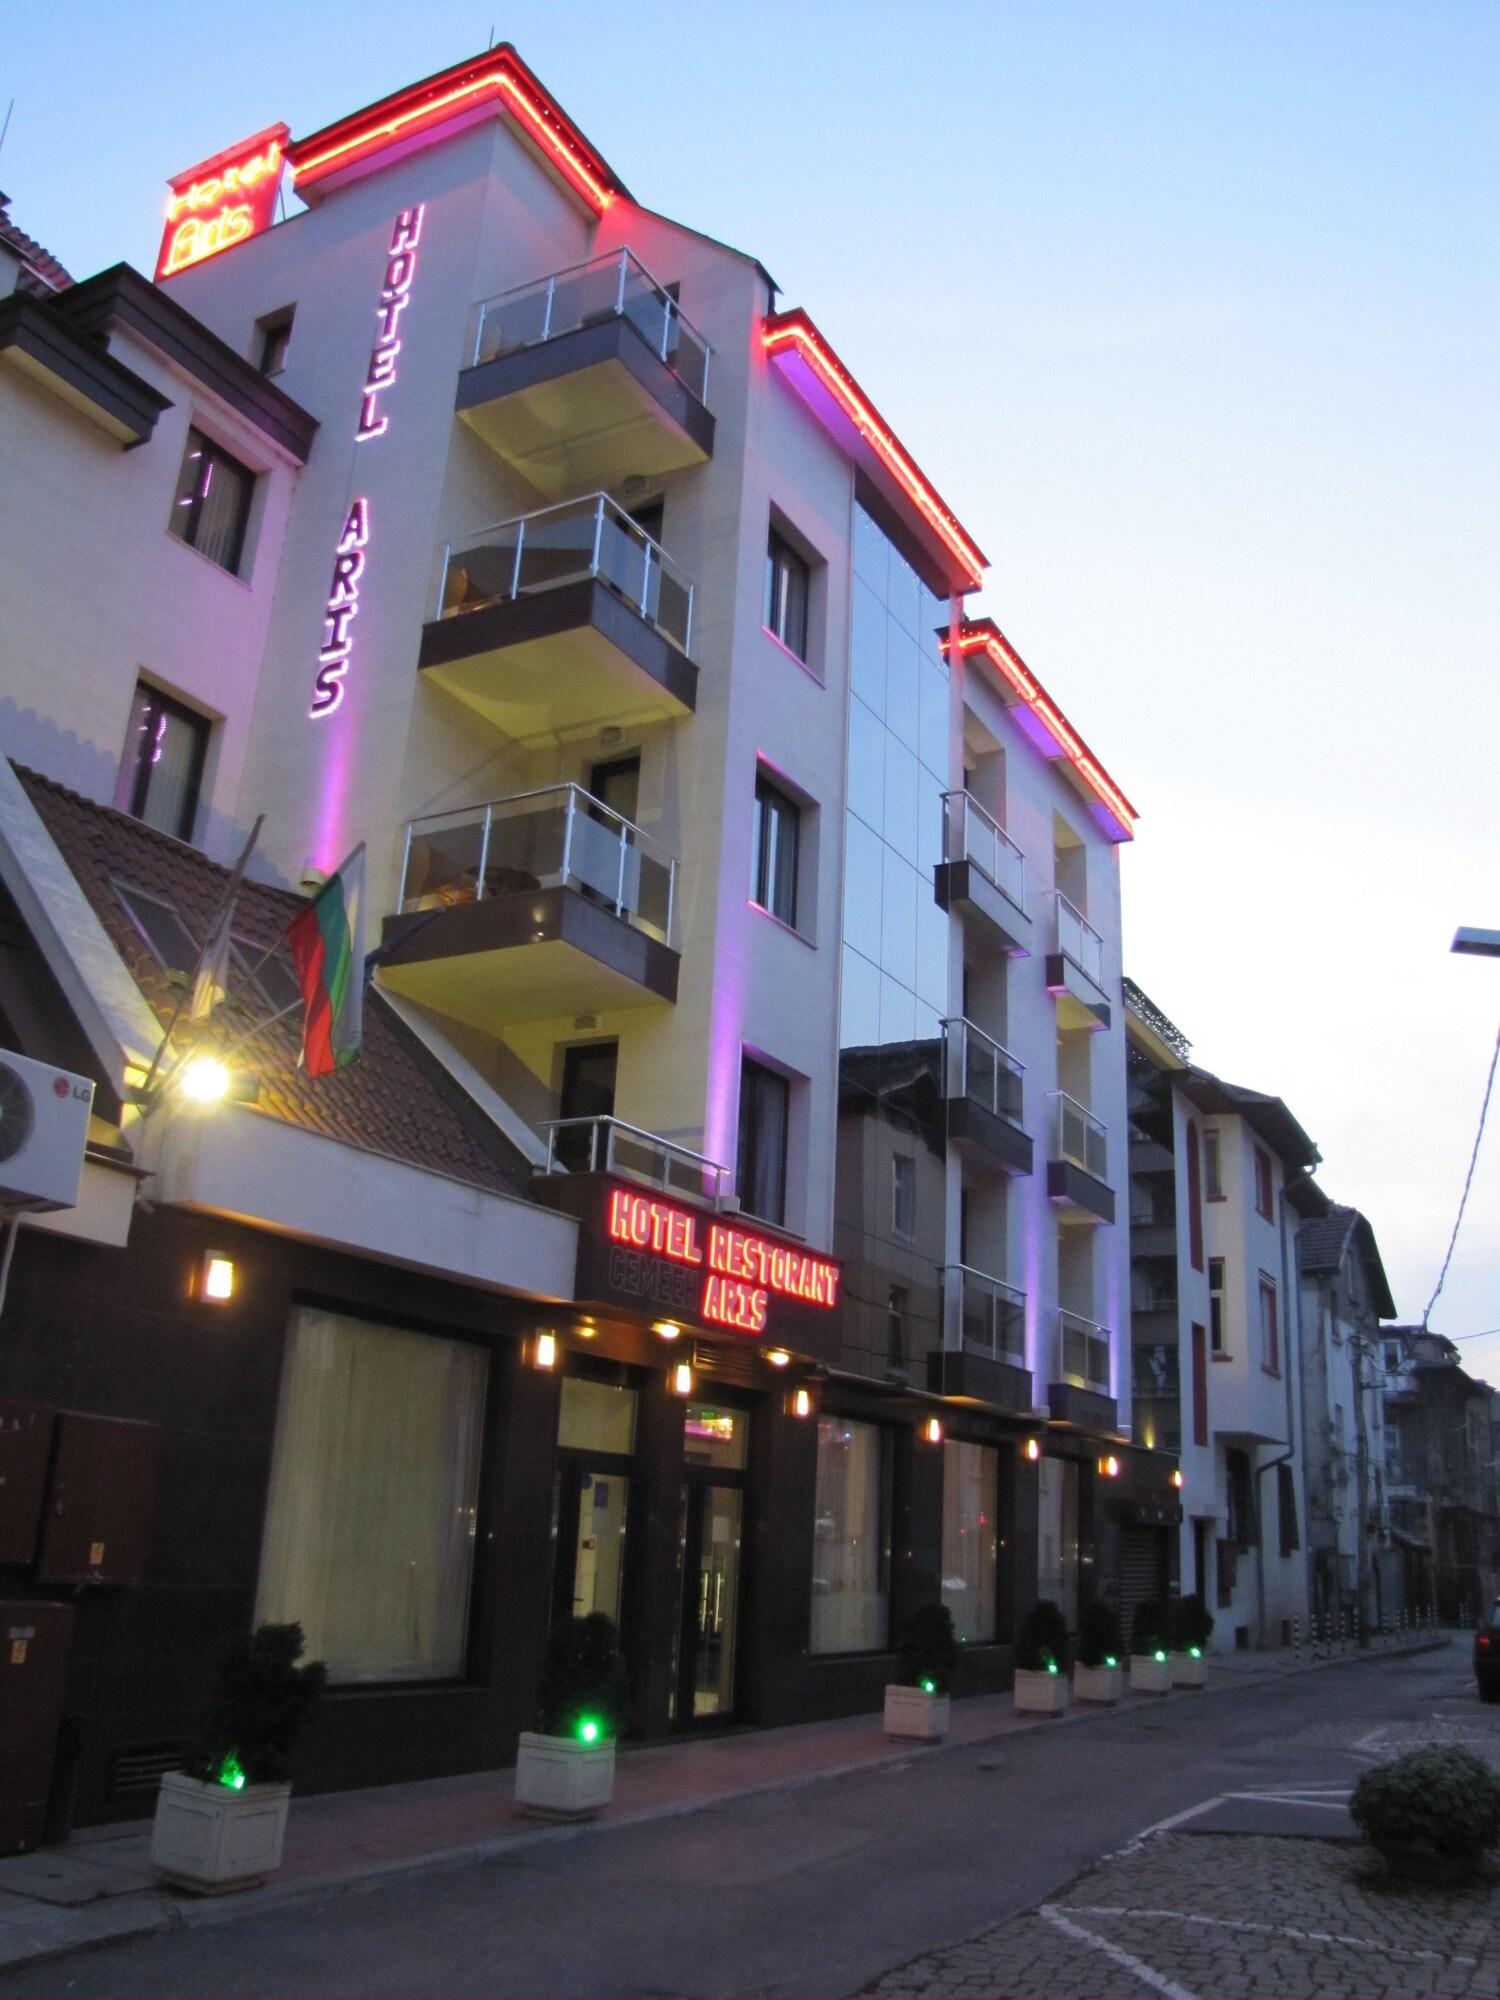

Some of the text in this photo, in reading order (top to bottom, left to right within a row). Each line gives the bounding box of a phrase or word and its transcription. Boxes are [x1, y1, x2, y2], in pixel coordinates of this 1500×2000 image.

[309, 203, 425, 719] HOTEL ARIS
[72, 1085, 91, 1103] LG
[610, 1190, 840, 1305] HOTEL RESTORANT
[703, 1275, 768, 1331] ARIS
